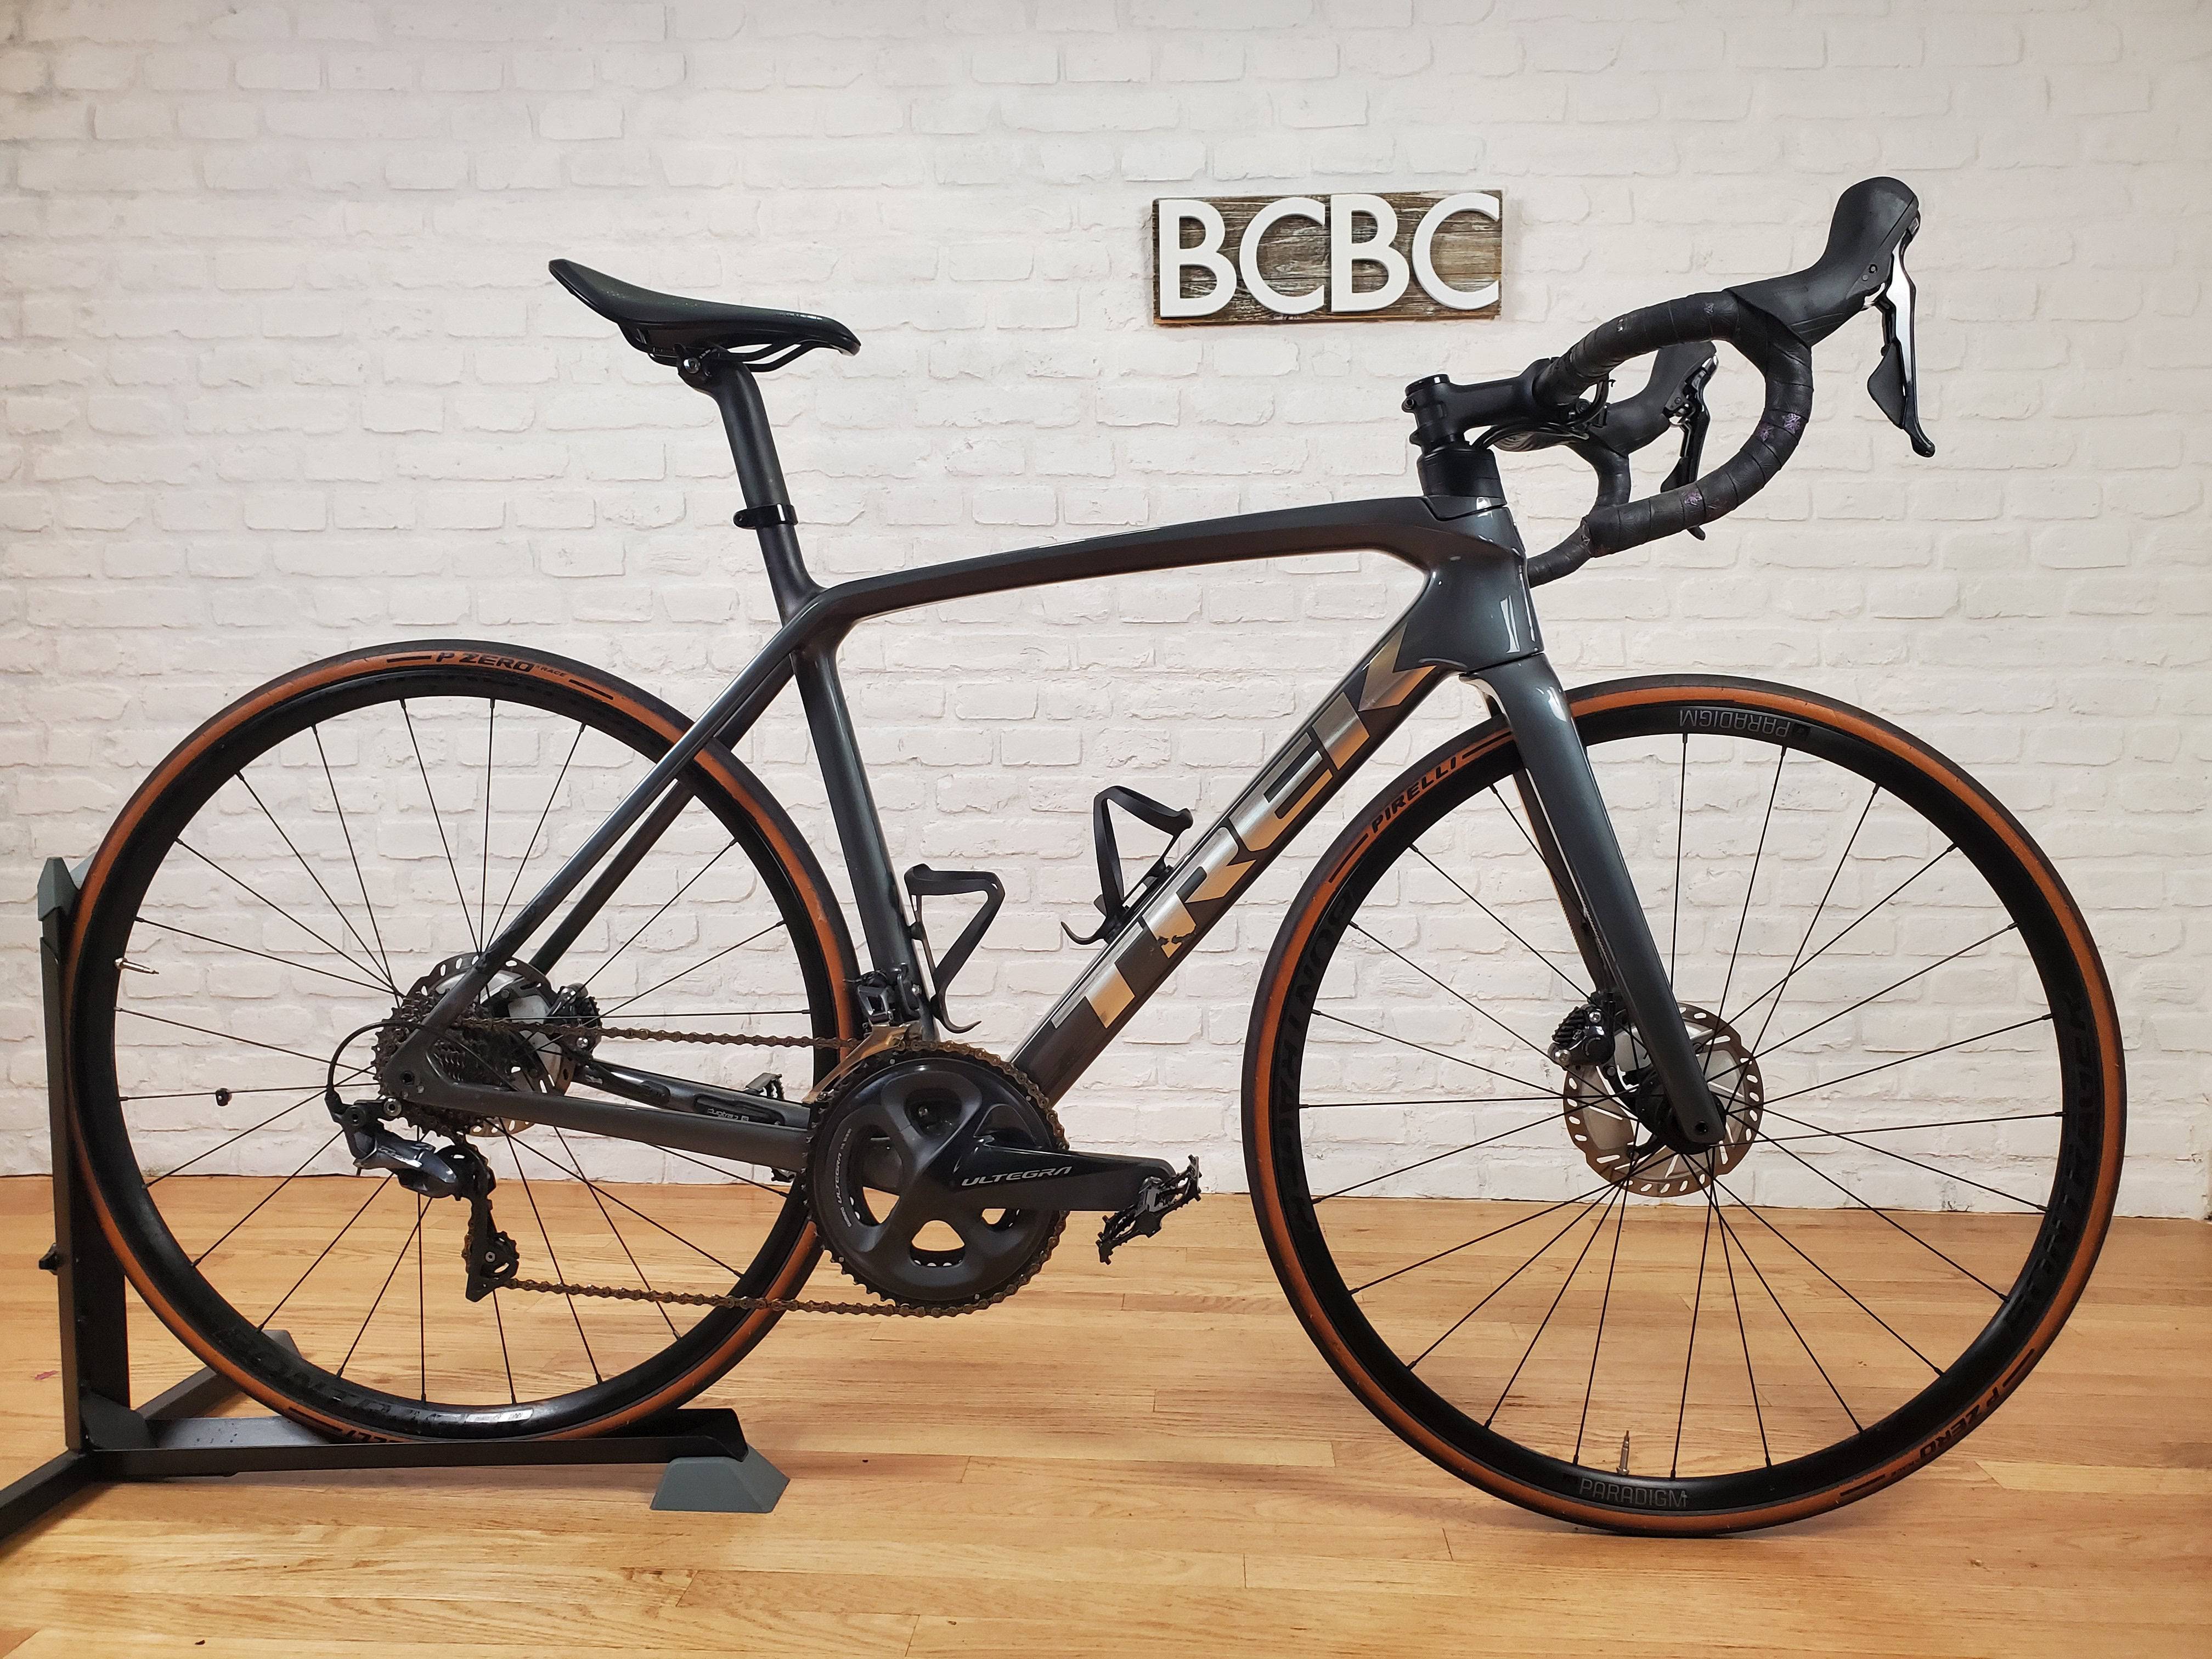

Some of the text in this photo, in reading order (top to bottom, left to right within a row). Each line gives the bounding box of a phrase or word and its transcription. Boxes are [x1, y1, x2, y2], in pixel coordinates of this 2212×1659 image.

[1158, 192, 1499, 317] BCBC
[436, 652, 568, 678] P ZERO RACE
[1679, 709, 1791, 737] PARADIGM
[1372, 755, 1457, 834] PIRELLI
[1051, 622, 1437, 1029] TREK
[961, 1166, 1073, 1186] ULTEGRA
[1579, 1477, 1688, 1508] PARADIGM
